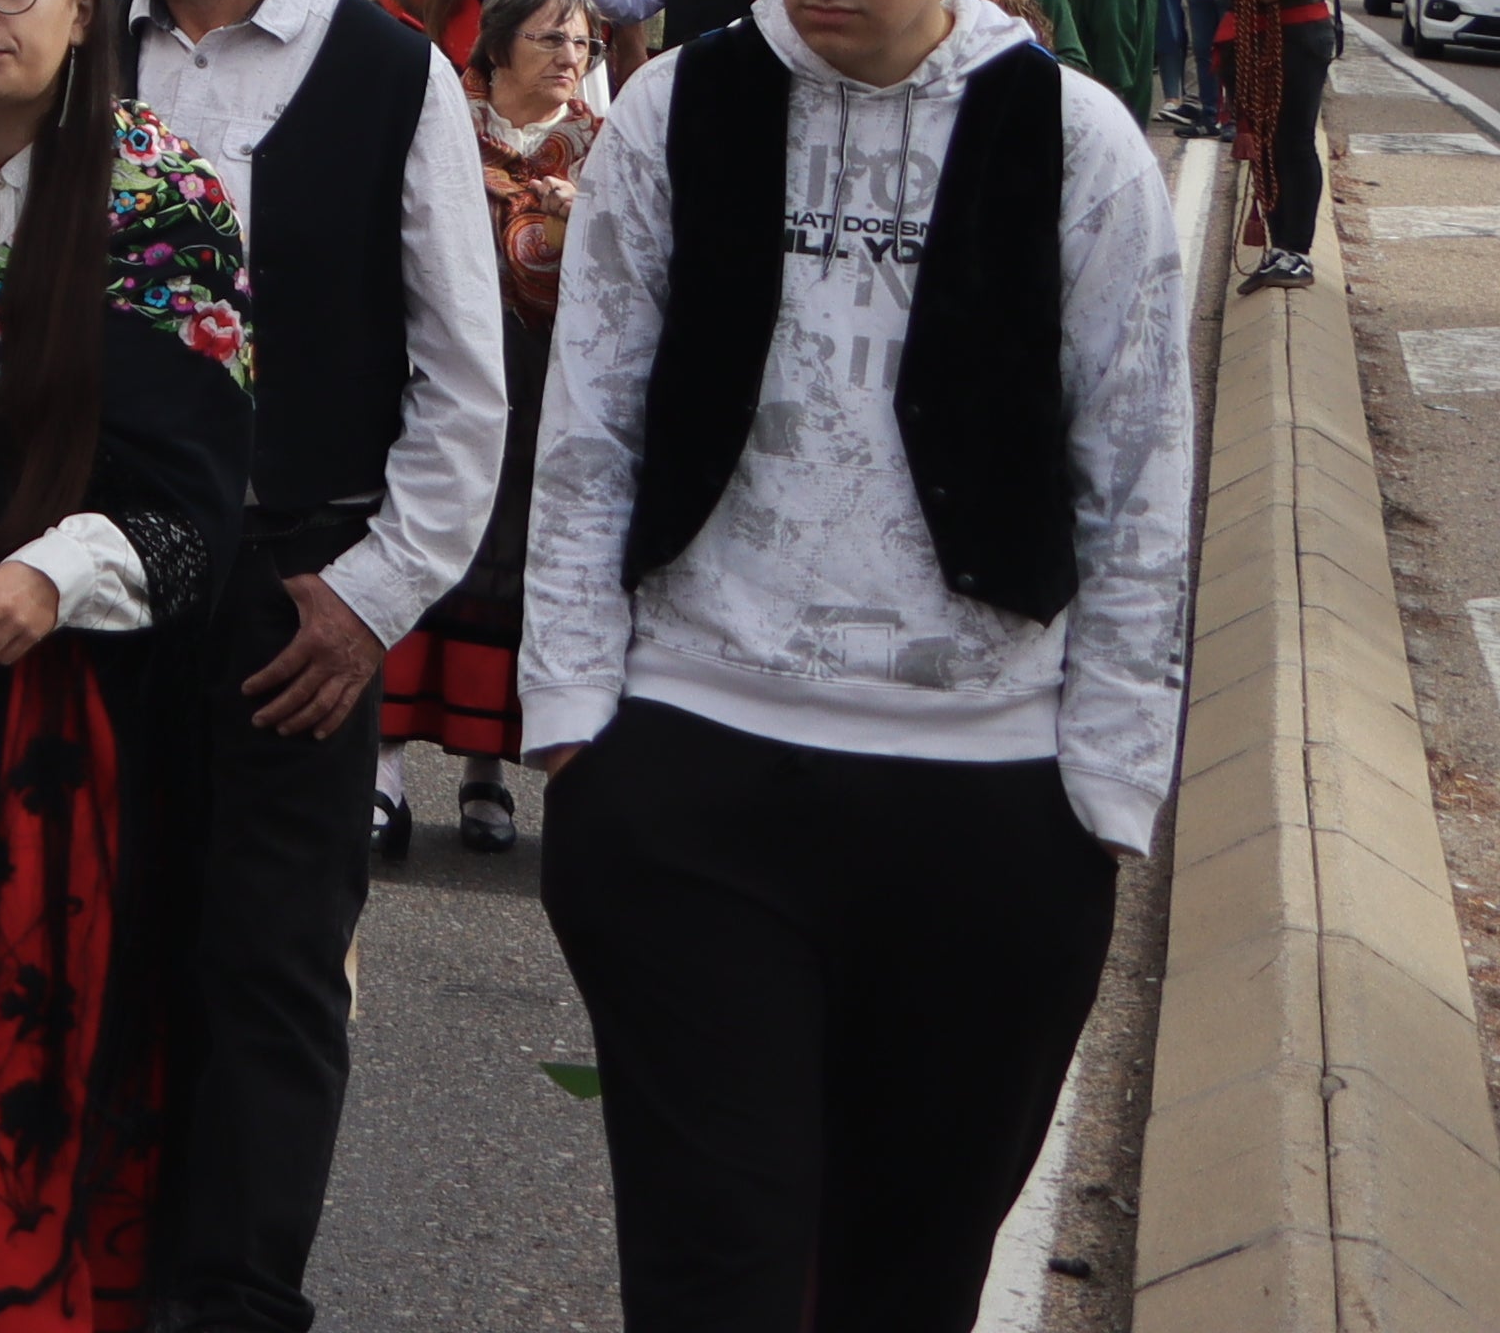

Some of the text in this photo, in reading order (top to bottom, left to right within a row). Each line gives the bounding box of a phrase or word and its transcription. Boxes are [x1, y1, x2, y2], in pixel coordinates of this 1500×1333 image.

[785, 210, 833, 229] HAT
[785, 228, 925, 264] ILL YO
